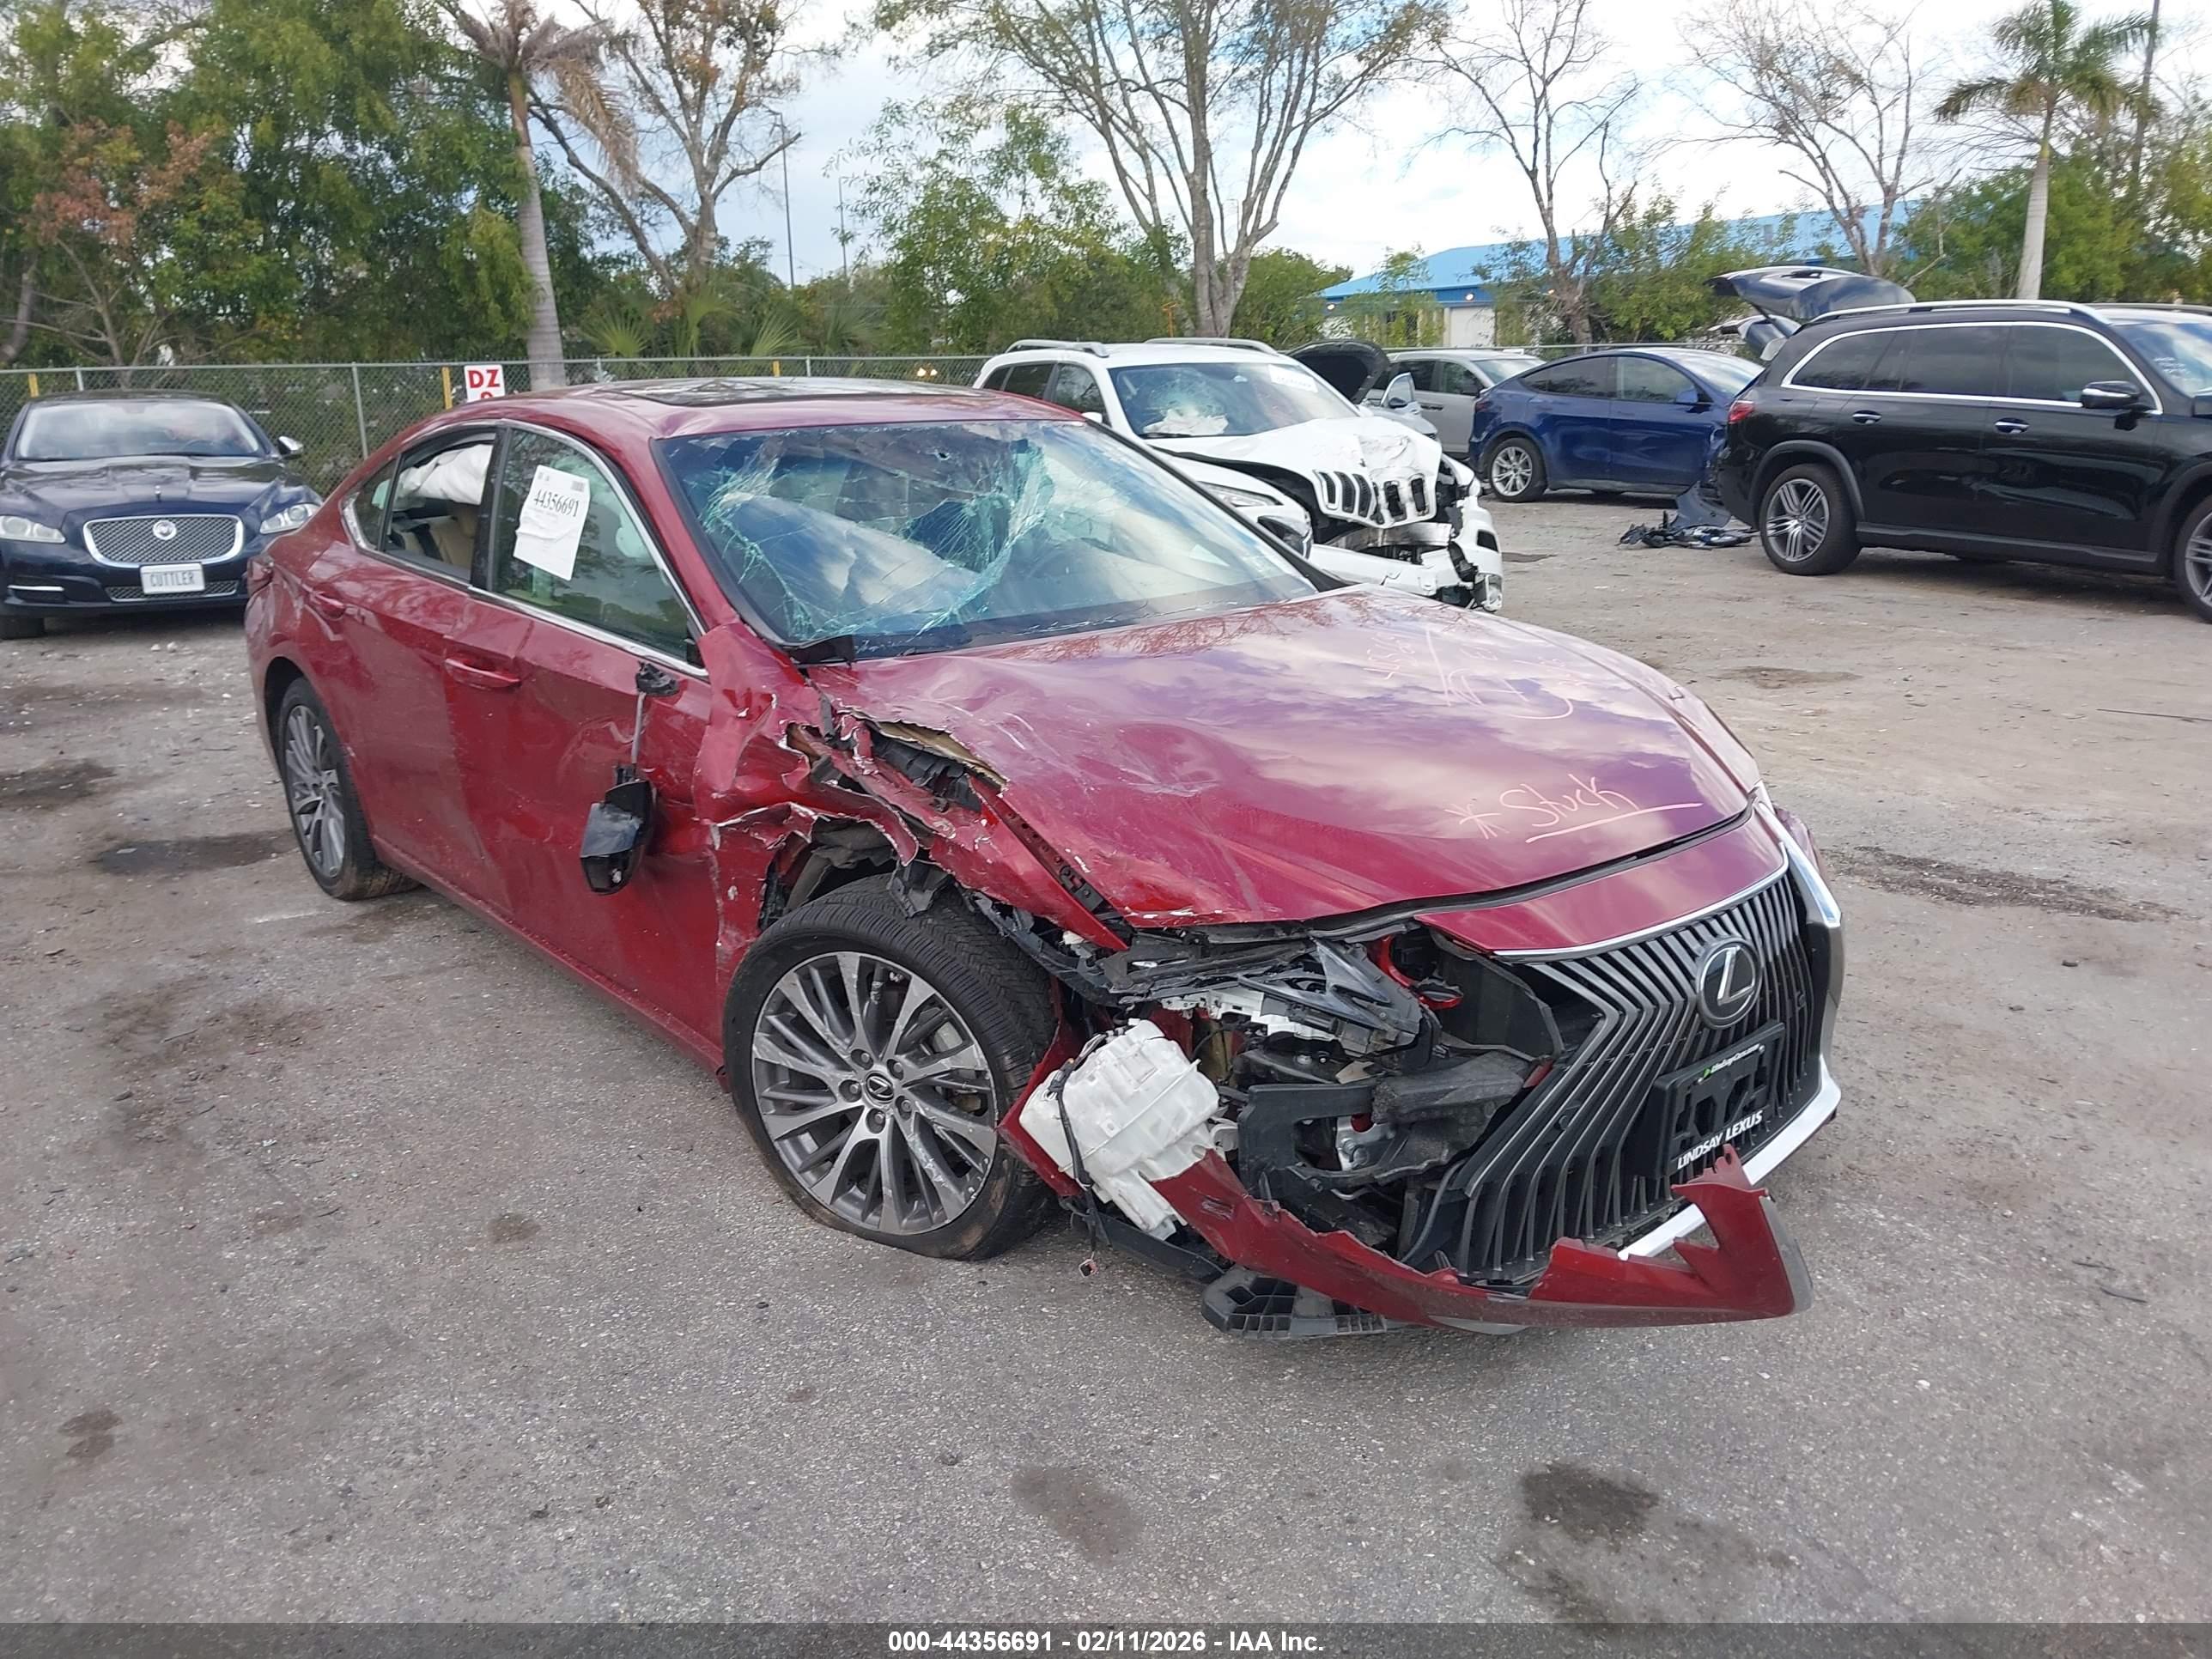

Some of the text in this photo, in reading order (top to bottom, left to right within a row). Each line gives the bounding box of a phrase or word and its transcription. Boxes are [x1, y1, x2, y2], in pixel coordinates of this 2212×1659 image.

[468, 369, 501, 388] DZ
[533, 489, 580, 517] 44356691
[150, 571, 195, 587] CUTTLER
[1677, 1109, 1763, 1170] LINDSAY LEXUS
